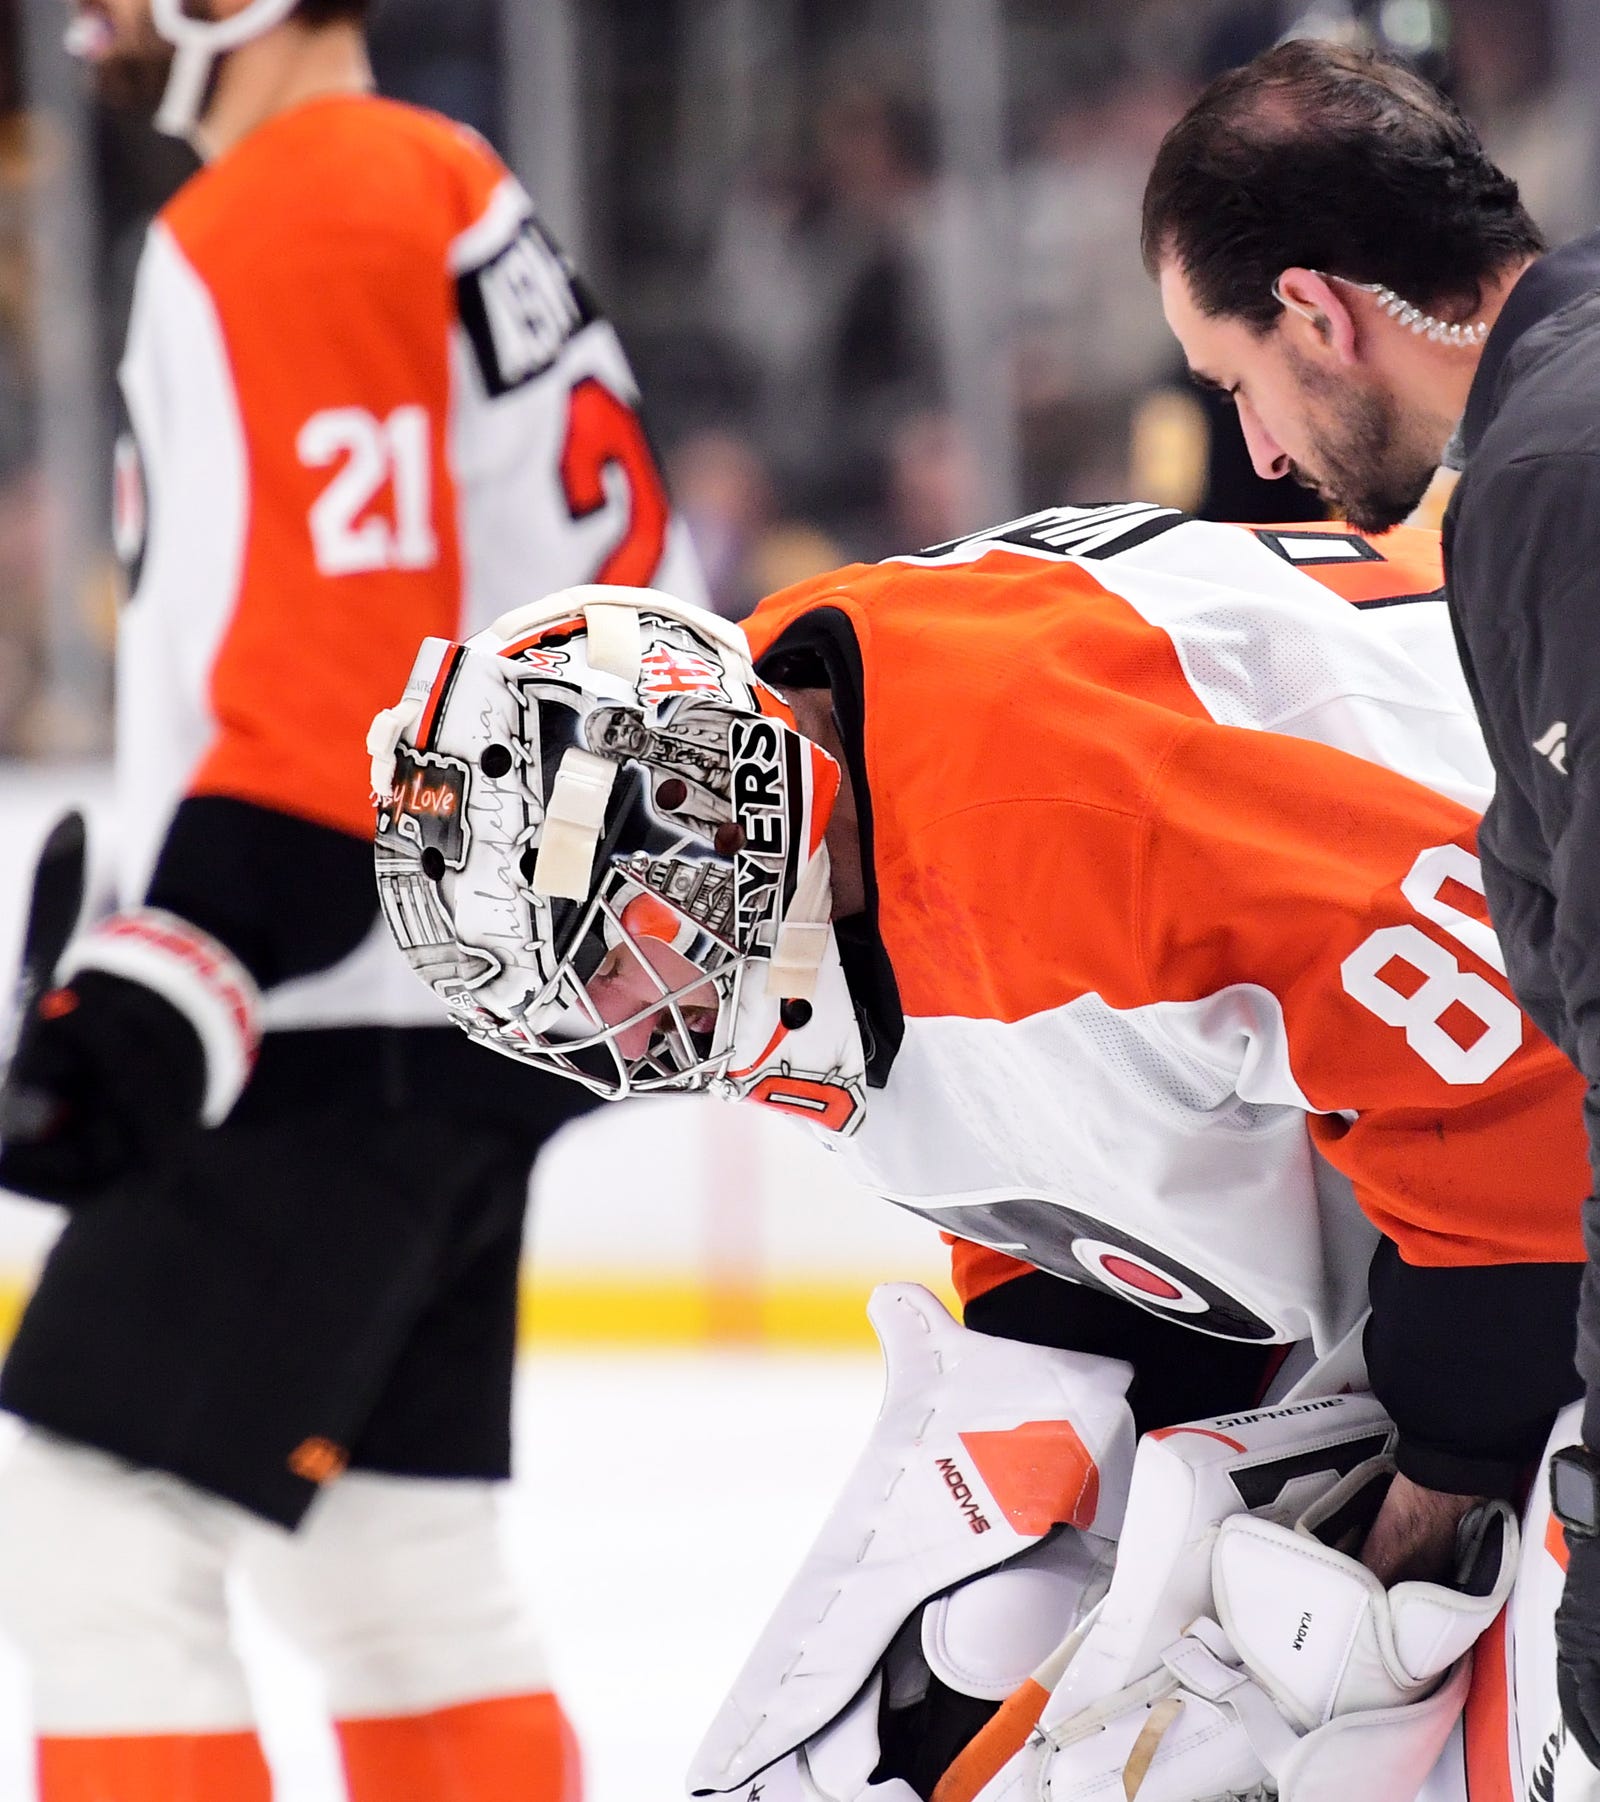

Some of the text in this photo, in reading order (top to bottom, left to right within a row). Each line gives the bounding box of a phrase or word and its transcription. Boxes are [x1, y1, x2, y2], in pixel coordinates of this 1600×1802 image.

[297, 405, 437, 577] 21
[411, 771, 456, 812] Love
[729, 718, 785, 962] FLYERS
[1340, 842, 1524, 1086] 80
[935, 1457, 991, 1535] SHADOW
[1292, 1611, 1312, 1651] VLADAR
